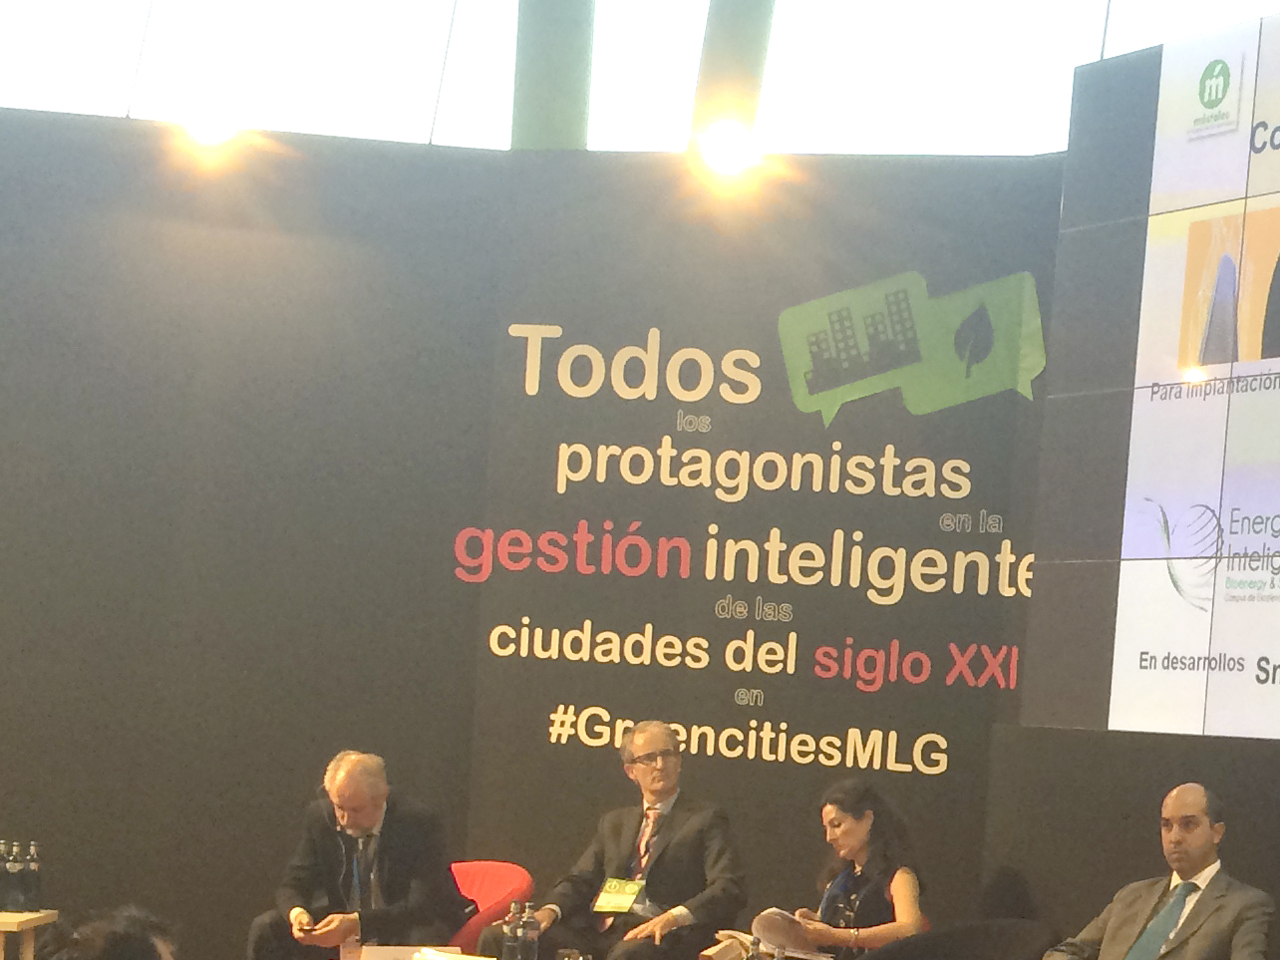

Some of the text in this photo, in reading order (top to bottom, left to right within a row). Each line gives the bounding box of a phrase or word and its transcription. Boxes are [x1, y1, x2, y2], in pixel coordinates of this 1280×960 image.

[508, 323, 762, 404] Todos
[1150, 381, 1182, 402] Para
[676, 409, 711, 433] los
[557, 435, 971, 502] protagonistas
[940, 509, 1003, 533] en la
[454, 520, 1035, 605] gestión inteligente
[715, 596, 793, 621] de las
[488, 616, 1019, 693] ciudades del siglo XXI
[1139, 651, 1157, 670] En
[1161, 652, 1245, 672] desarrollos
[735, 686, 764, 706] en
